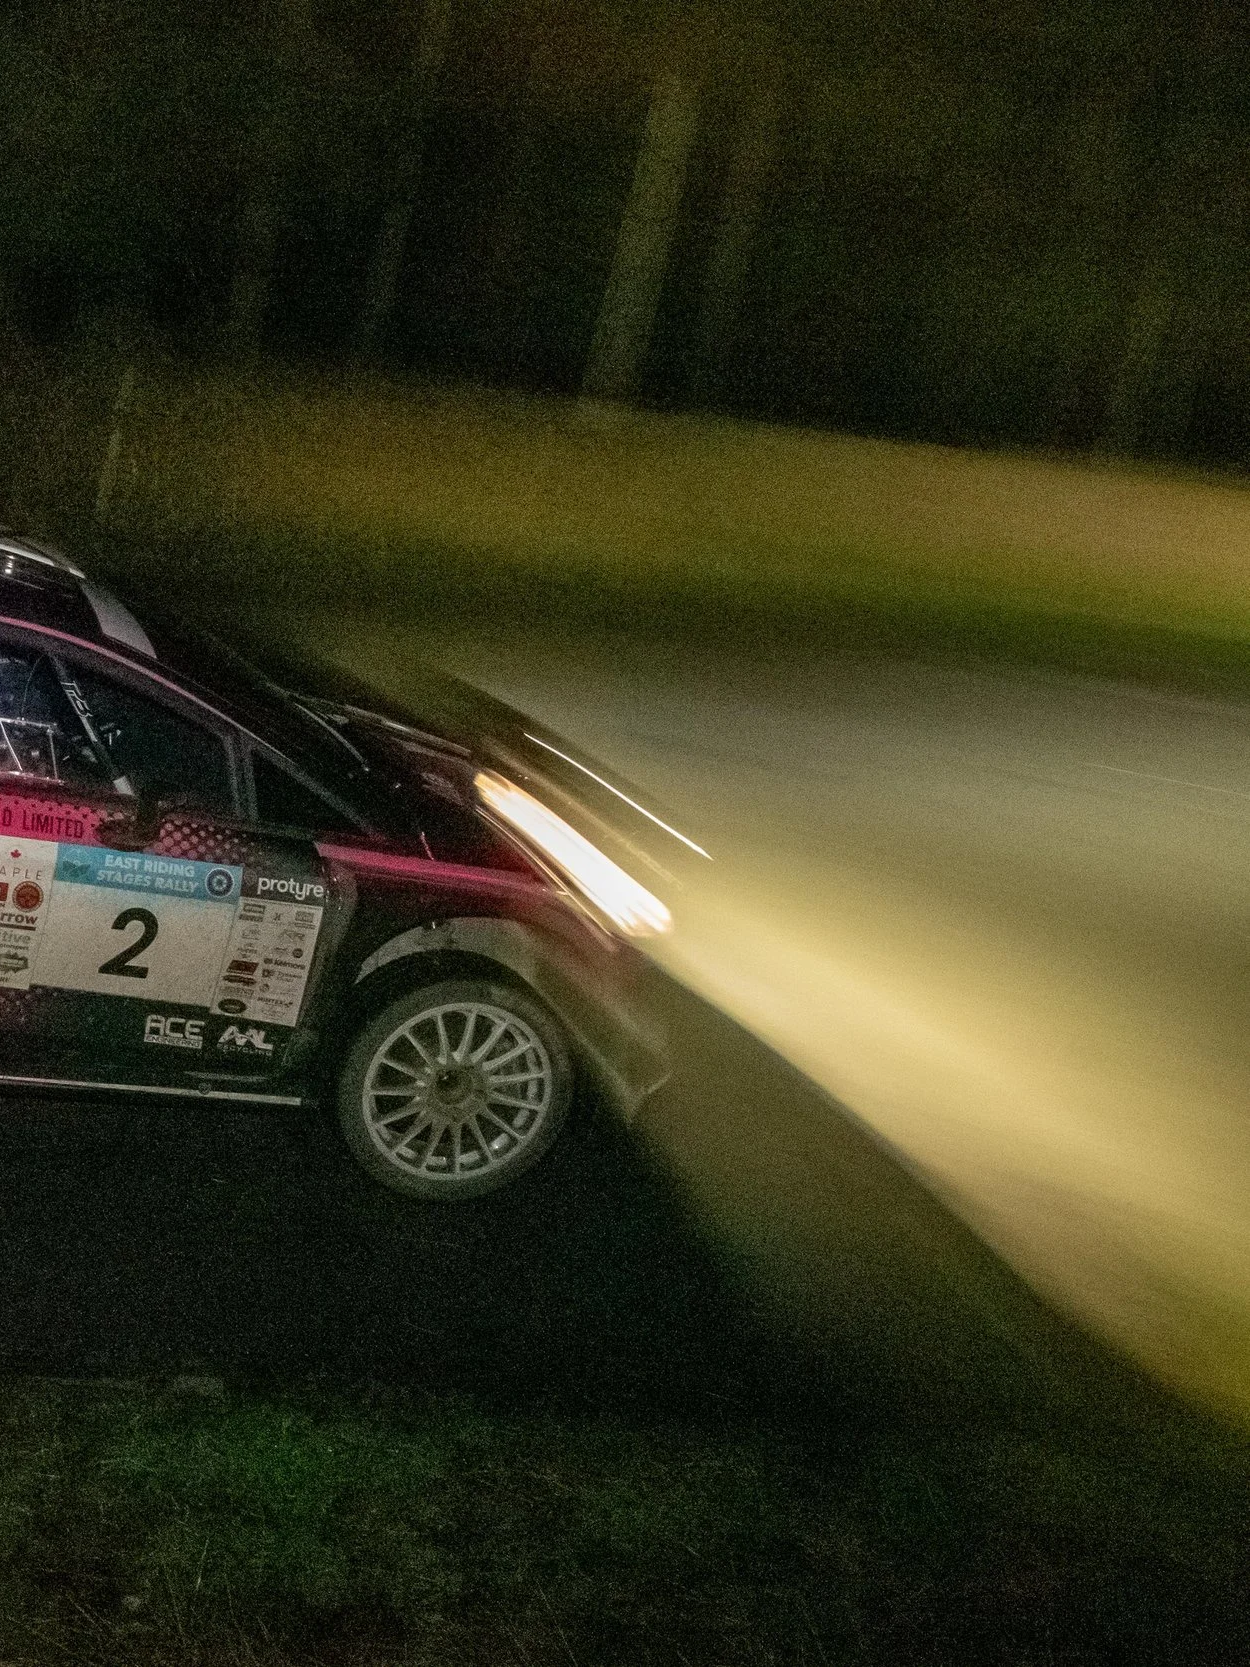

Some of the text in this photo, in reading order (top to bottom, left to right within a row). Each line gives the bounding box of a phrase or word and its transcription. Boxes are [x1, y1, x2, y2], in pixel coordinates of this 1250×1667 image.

[22, 809, 84, 839] LIMITED
[104, 854, 195, 878] EAST RIDING
[97, 870, 200, 893] STAGES RALLY
[256, 876, 325, 901] protyre
[98, 907, 159, 979] 2
[145, 1014, 205, 1039] ACE
